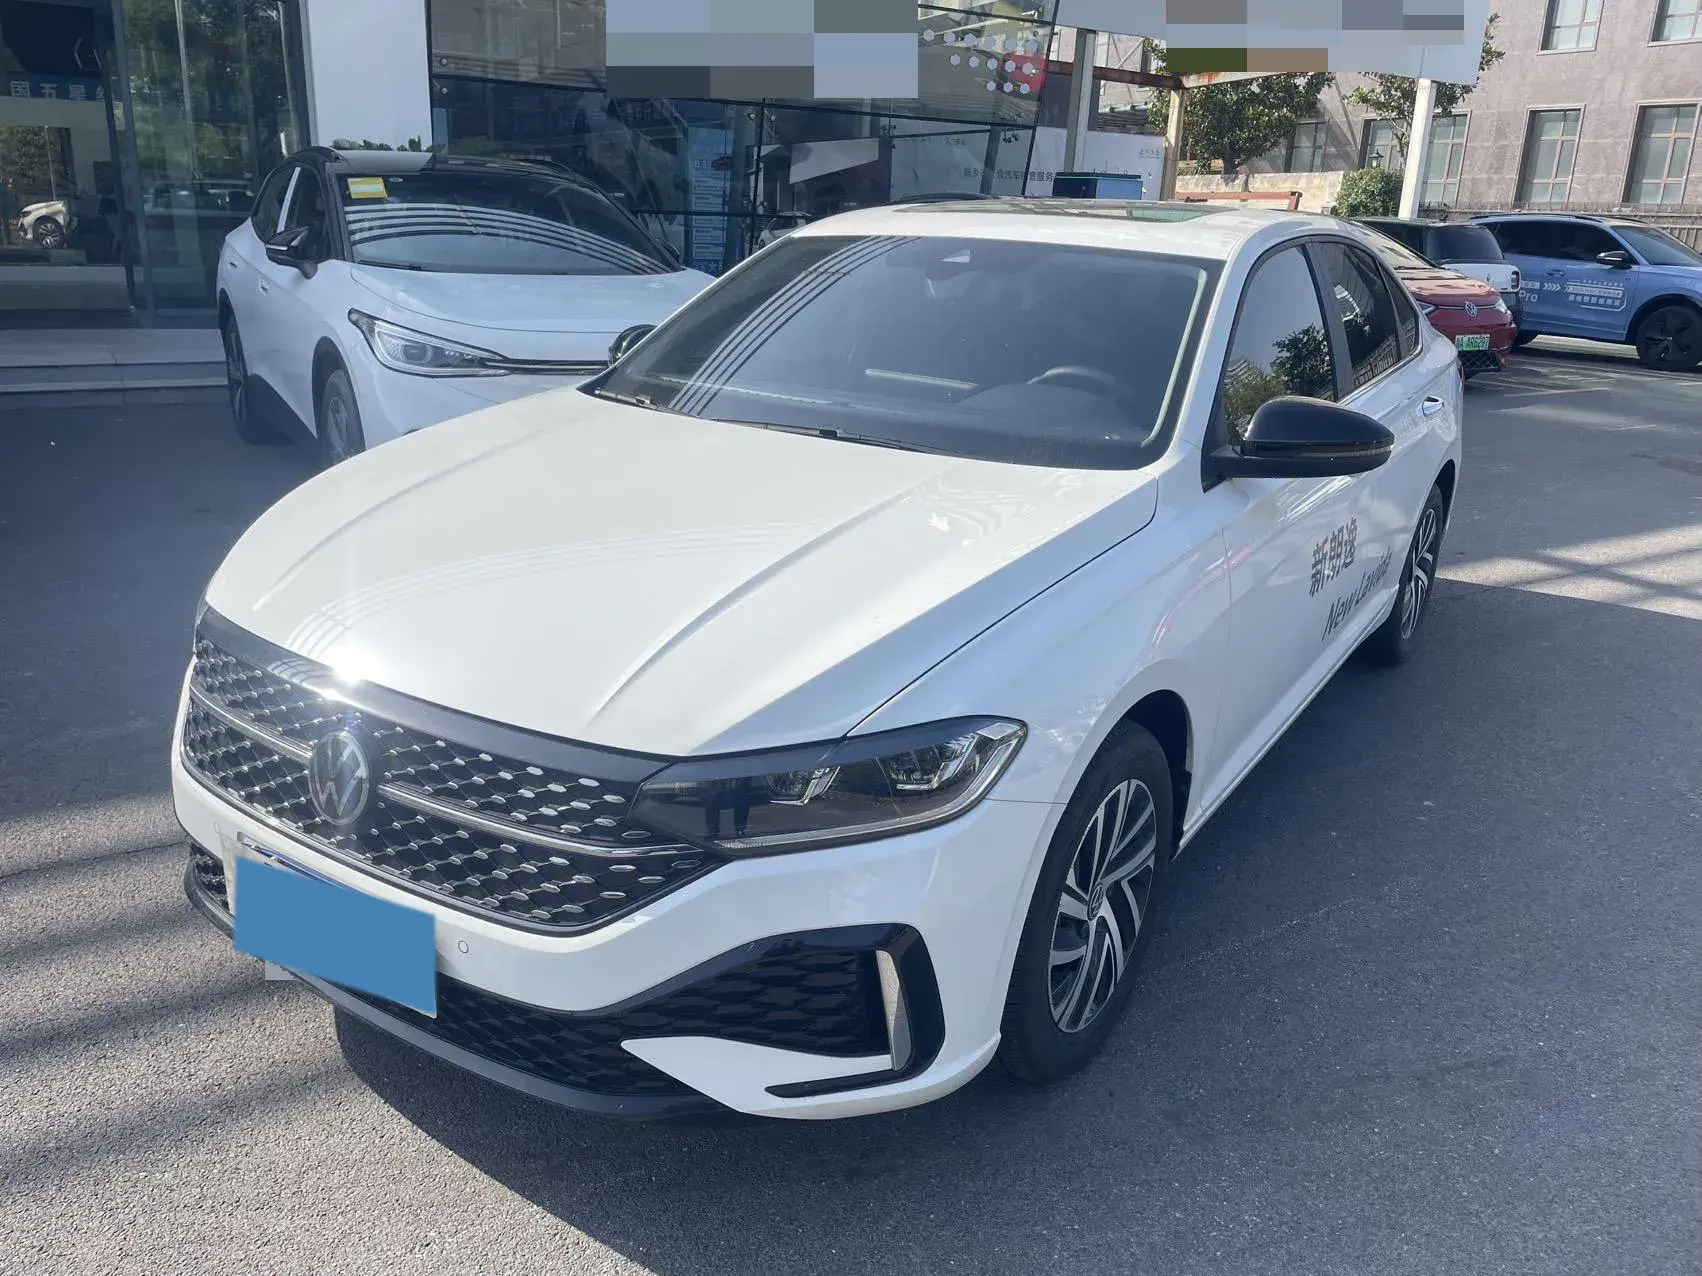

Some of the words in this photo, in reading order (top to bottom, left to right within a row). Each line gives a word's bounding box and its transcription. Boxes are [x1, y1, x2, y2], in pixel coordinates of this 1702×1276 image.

[1309, 517, 1358, 597] 新朗逸
[1321, 588, 1357, 644] New
